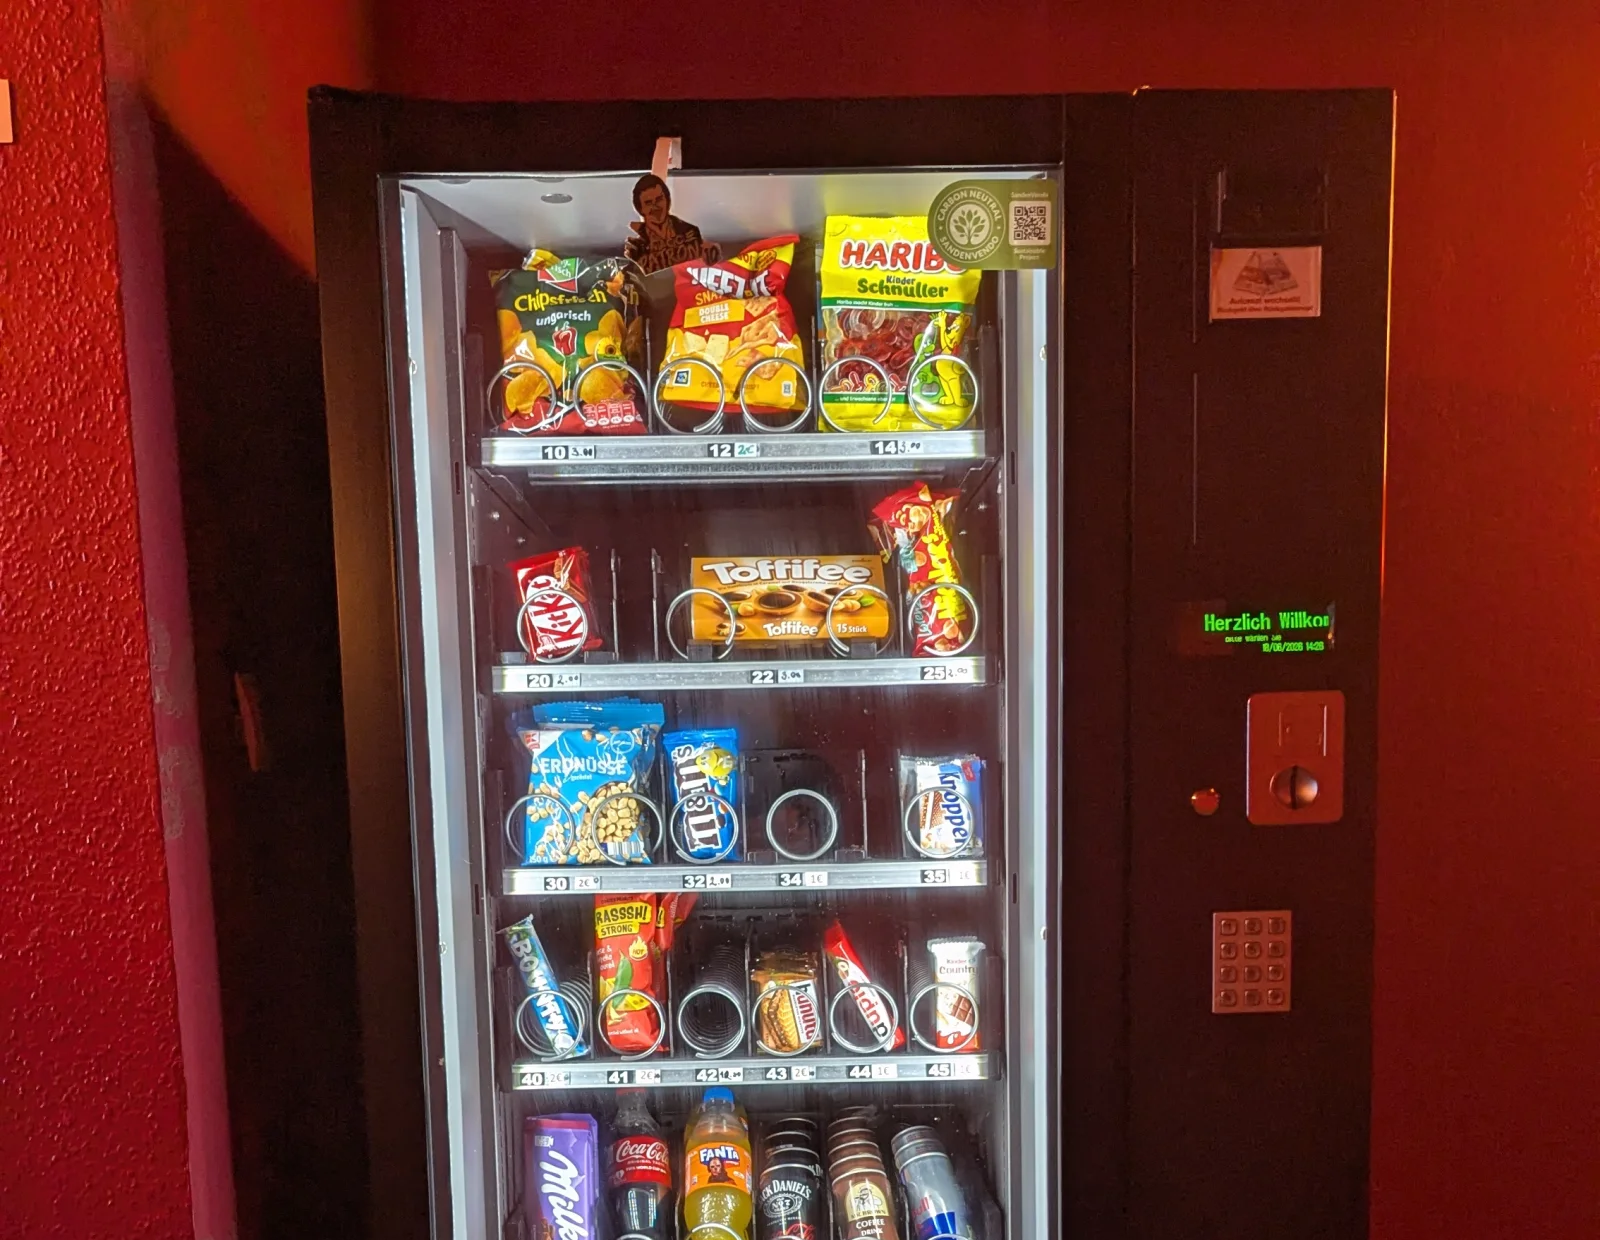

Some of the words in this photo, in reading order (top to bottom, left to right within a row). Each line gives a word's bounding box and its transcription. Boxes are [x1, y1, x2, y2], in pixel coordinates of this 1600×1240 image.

[937, 190, 968, 221] CARBON
[969, 190, 1002, 221] NEUTRAL
[939, 236, 999, 260] SANDENVENDO
[841, 240, 963, 272] HARIB
[885, 275, 916, 286] Kinder
[857, 277, 949, 298] Schnuller
[514, 289, 608, 312] Chipsfrisch
[698, 303, 730, 316] DOUBLE
[535, 310, 592, 326] ungarisch
[700, 312, 729, 323] CHEESE
[543, 446, 567, 459] 10
[709, 444, 732, 457] 12
[874, 441, 897, 454] 14
[702, 559, 873, 585] Toffifee
[762, 620, 819, 637] Toffifee
[836, 623, 848, 634] 15
[848, 623, 868, 634] Stück
[1204, 612, 1272, 632] Herzlich
[751, 670, 774, 684] 22
[923, 667, 946, 680] 25
[528, 674, 551, 687] 20
[556, 675, 579, 685] 2.00
[540, 755, 628, 776] ERDNÜSSE
[938, 772, 970, 850] Knopper
[684, 875, 706, 888] 32
[708, 876, 730, 887] 2.00
[780, 873, 802, 886] 34
[810, 874, 823, 884] 1€
[923, 870, 945, 883] 35
[959, 871, 970, 880] 1€
[545, 877, 568, 890] 30
[578, 878, 590, 887] 2€
[596, 906, 648, 926] RASSSH!
[600, 924, 633, 936] STRONG
[847, 979, 879, 1037] duplo
[608, 1070, 629, 1084] 41
[640, 1070, 653, 1080] 2€
[696, 1068, 718, 1082] 42
[766, 1067, 788, 1080] 43
[795, 1068, 808, 1077] 2€
[849, 1065, 871, 1078] 44
[878, 1067, 890, 1076] 1€
[928, 1064, 951, 1077] 45
[521, 1072, 543, 1085] 40
[616, 1140, 670, 1164] Coca-Cola
[699, 1145, 739, 1162] FANTA
[772, 1179, 812, 1201] DANIEL'S
[855, 1218, 886, 1229] COFFEE
[860, 1227, 884, 1237] DRINK
